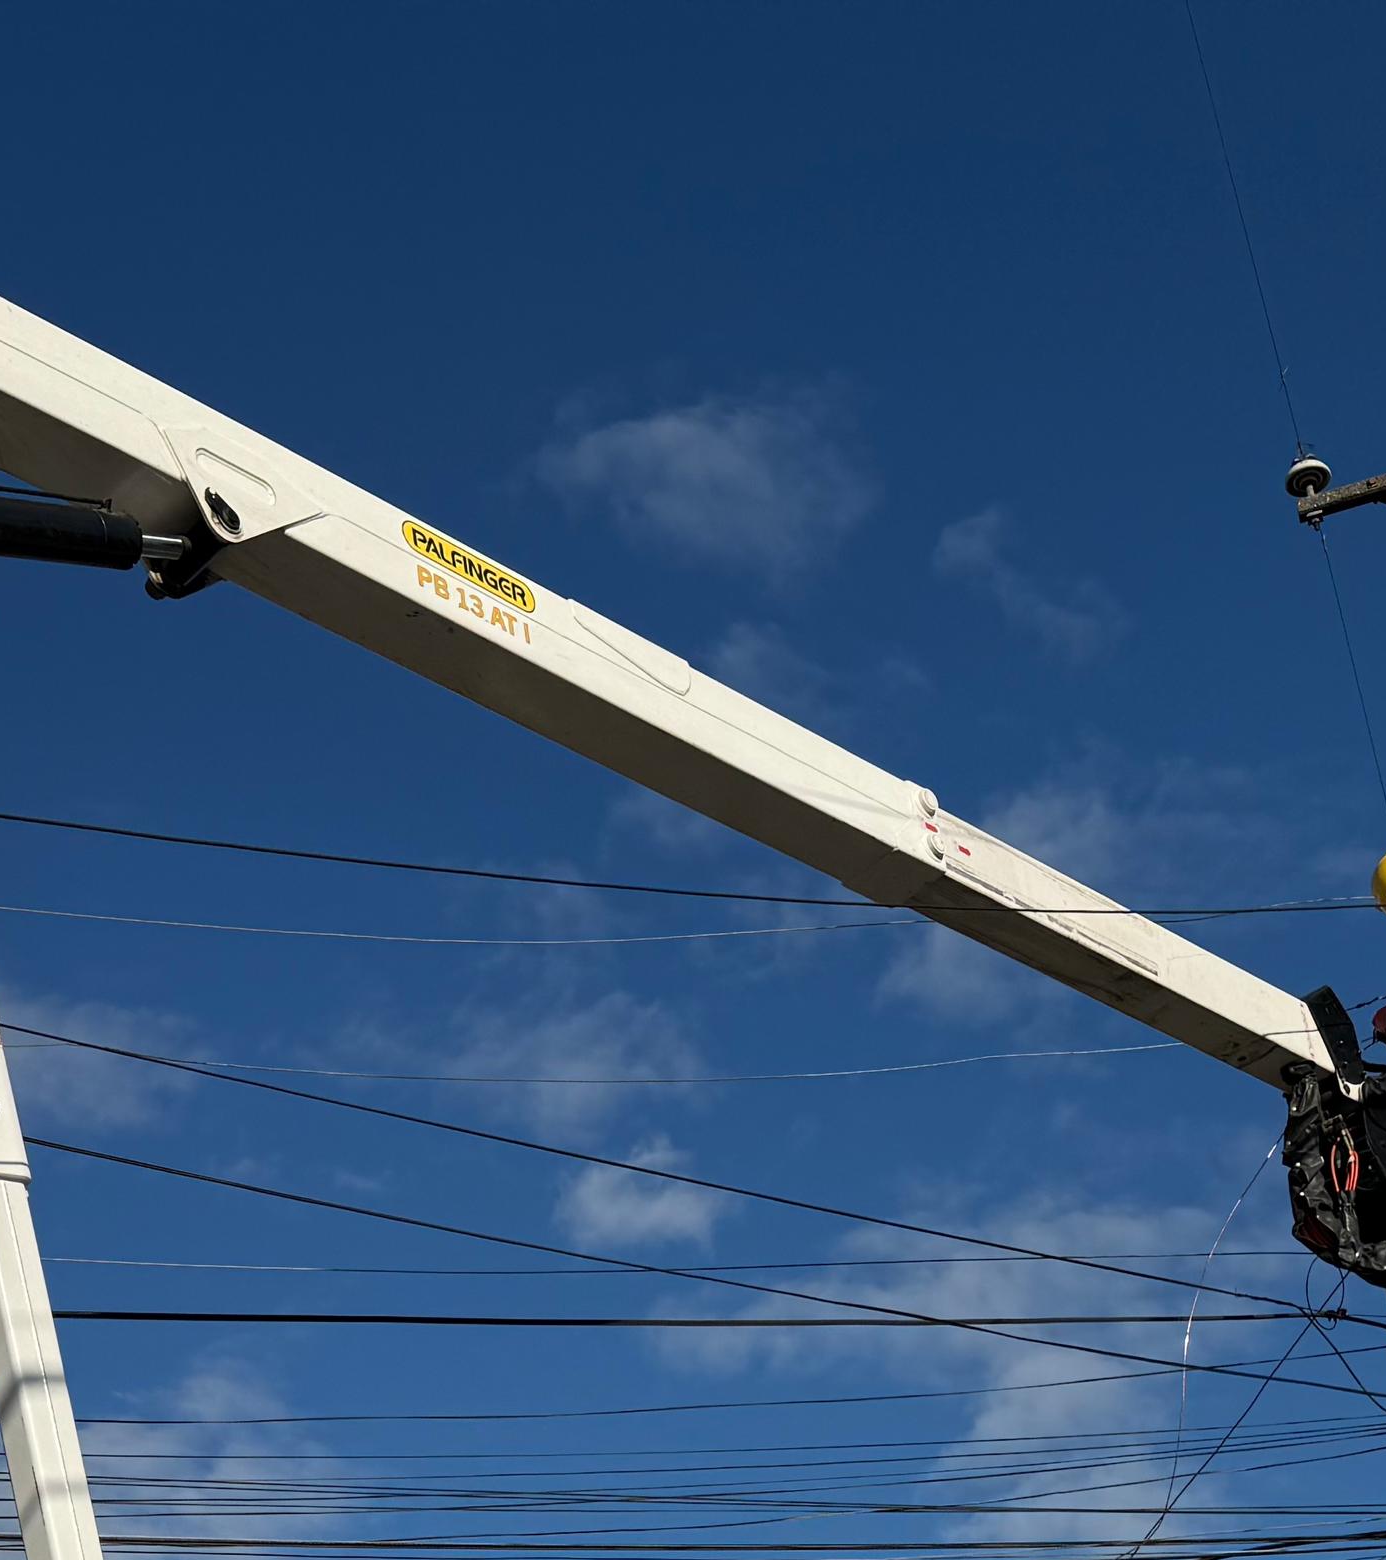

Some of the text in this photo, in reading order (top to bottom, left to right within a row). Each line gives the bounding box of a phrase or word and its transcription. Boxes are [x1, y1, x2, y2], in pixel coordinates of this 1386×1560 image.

[412, 528, 527, 607] PALFINGER
[416, 565, 450, 600] PB
[456, 588, 486, 619] 13
[490, 607, 517, 636] AT
